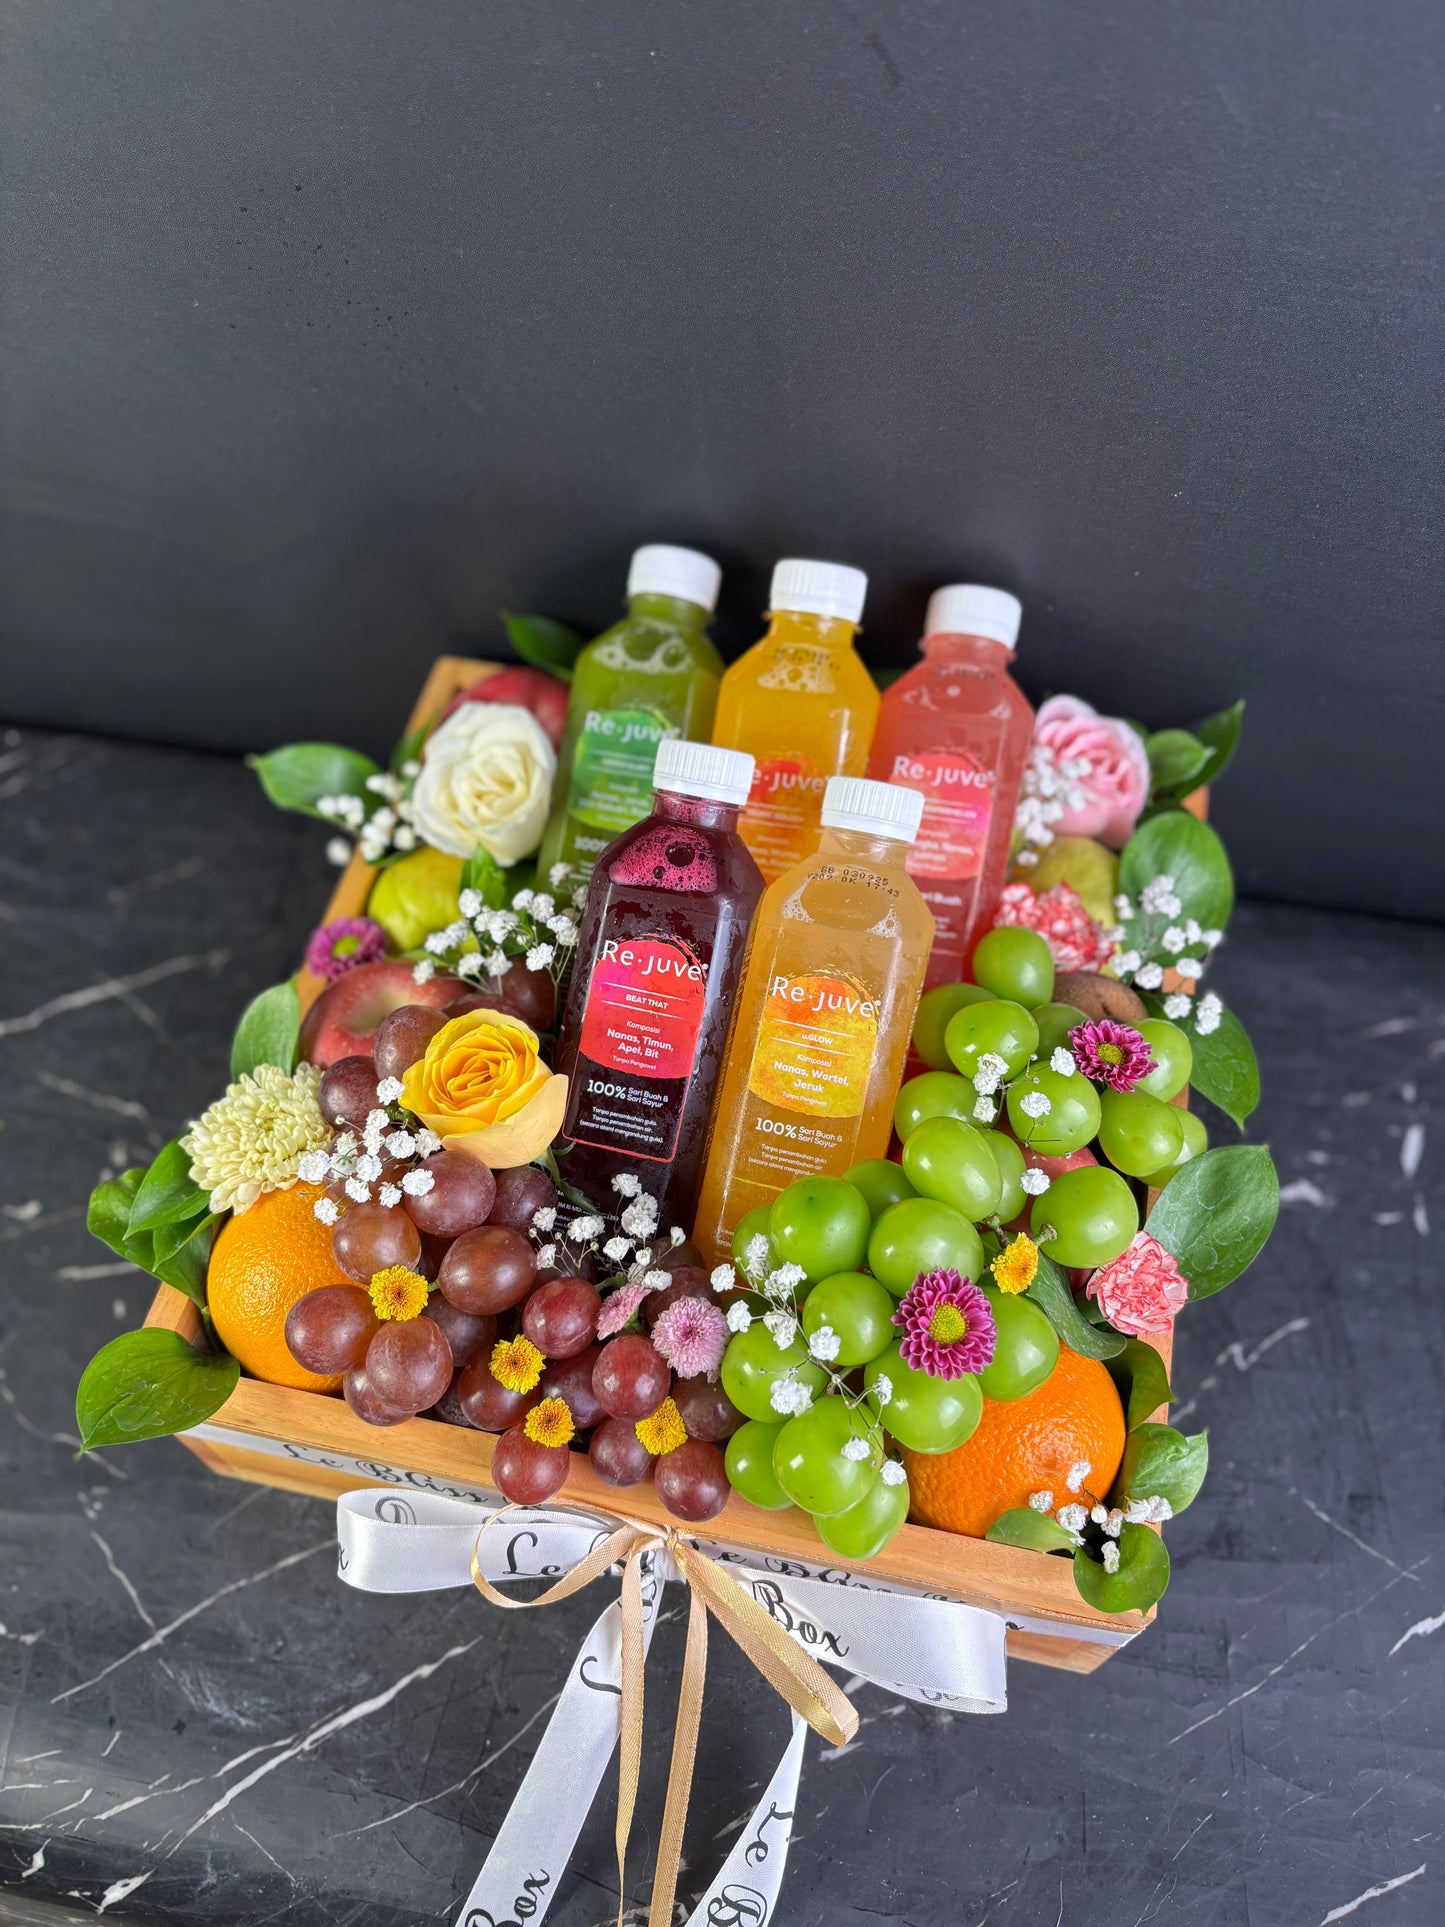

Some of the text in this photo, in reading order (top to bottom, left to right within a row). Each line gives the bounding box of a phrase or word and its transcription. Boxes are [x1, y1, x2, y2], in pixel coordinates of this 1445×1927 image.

[626, 994, 669, 1010] BEAT THAT
[626, 1020, 661, 1034] Komposisi
[607, 1028, 674, 1052] Nanas, Timun,
[801, 1033, 834, 1045] u.GLOW
[618, 1042, 659, 1058] Apel, Bit
[612, 1055, 657, 1070] Tanpa Pengawet
[797, 1053, 832, 1067] Komposisi
[774, 1061, 808, 1078] Nanas,
[587, 1079, 626, 1099] 100%
[628, 1087, 643, 1096] Sari
[643, 1091, 662, 1101] Buah
[794, 1079, 824, 1092] Jeruk
[627, 1095, 663, 1109] Sari Sayur
[782, 1091, 800, 1100] Tanpa
[592, 1106, 609, 1115] Tanpa
[609, 1112, 644, 1124] penambahan
[592, 1114, 609, 1123] Tanpa
[609, 1120, 644, 1131] penambahan
[755, 1117, 797, 1139] 100%
[799, 1126, 814, 1136] Sari
[816, 1130, 835, 1141] Buah
[797, 1134, 837, 1149] Sari Sayur
[761, 1144, 778, 1153] Tanpa
[778, 1149, 815, 1161] penambahan
[761, 1151, 778, 1161] Tanpa
[778, 1157, 815, 1168] penambahan
[282, 1443, 489, 1503] Le Bliss
[752, 1579, 850, 1658] Box
